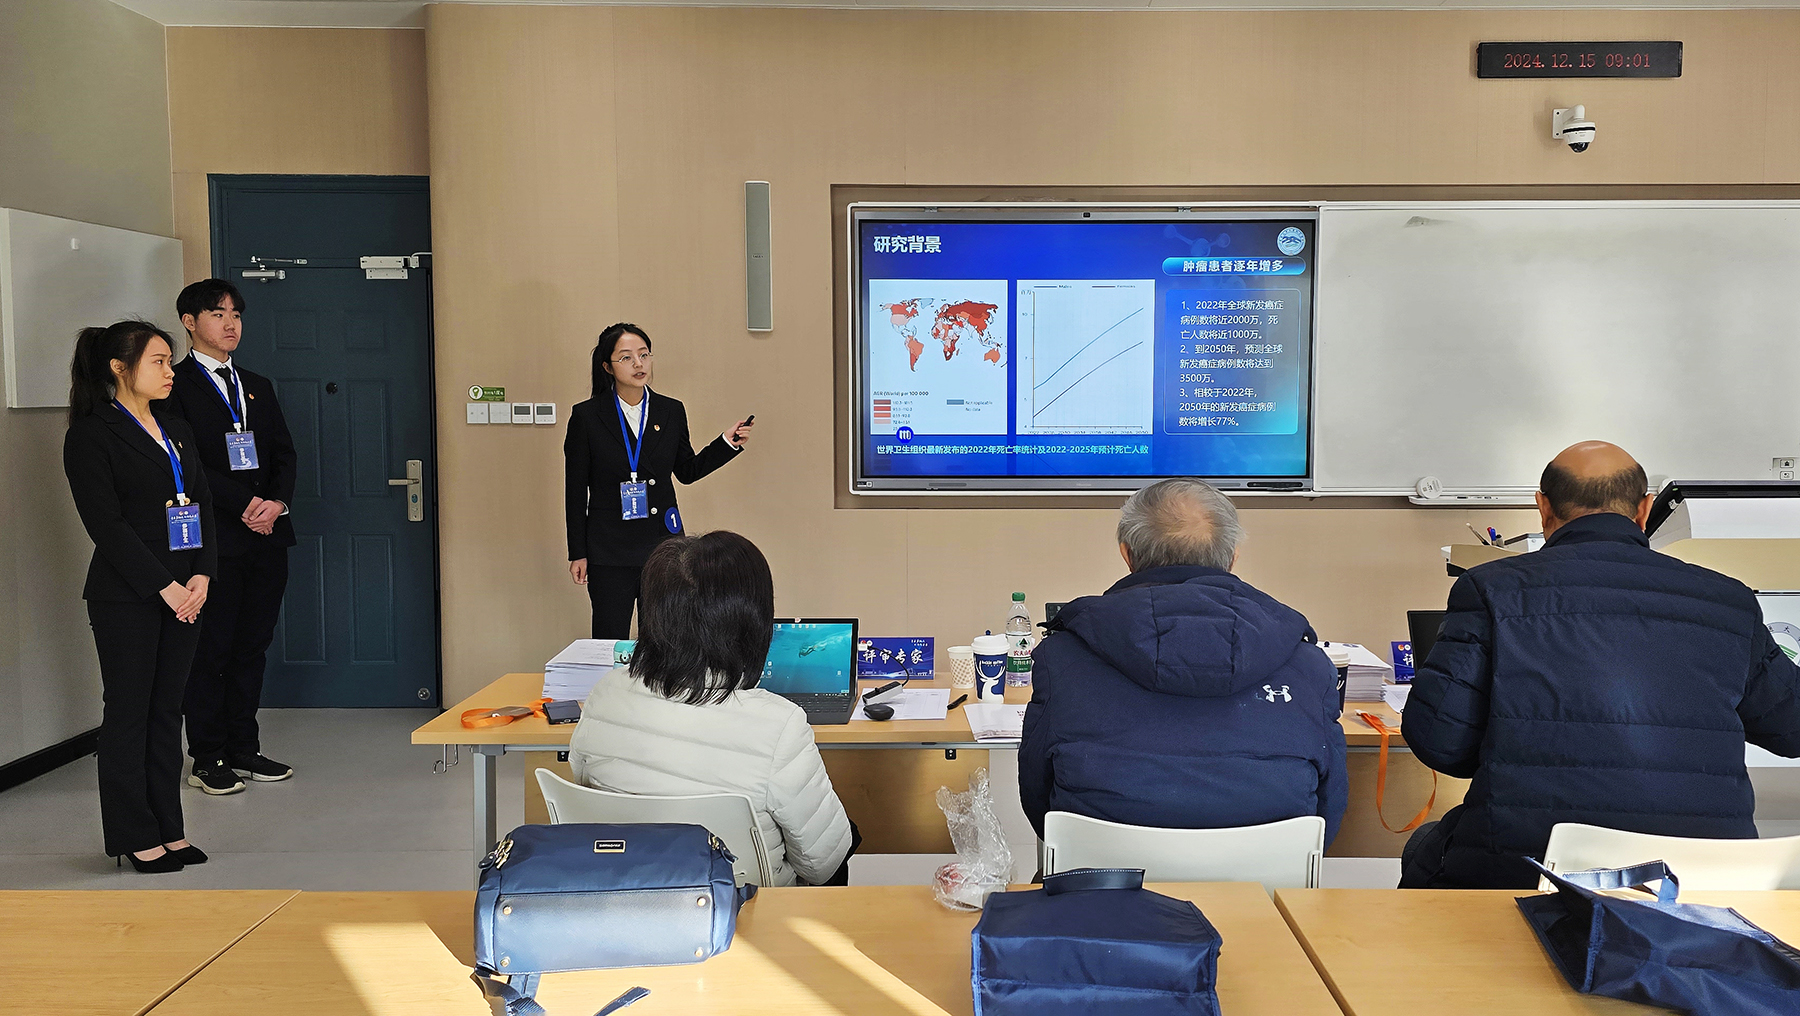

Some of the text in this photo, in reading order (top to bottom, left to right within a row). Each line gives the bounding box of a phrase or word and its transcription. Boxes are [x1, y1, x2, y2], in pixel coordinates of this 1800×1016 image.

[1605, 53, 1650, 68] 09:01
[873, 235, 942, 253] 研究背景
[1182, 259, 1284, 273] 肿瘤患者逐年增多
[1181, 300, 1284, 311] 1、2022年全球新发癌症
[1180, 329, 1263, 340] 亡人数将近1000万。
[1179, 358, 1274, 369] 新发癌症病例数将达到
[1179, 373, 1215, 384] 3500万。
[1178, 402, 1276, 413] 2050年的新发癌症病例
[1178, 416, 1240, 427] 数将增长77%。
[876, 445, 1149, 455] 世界卫生组织最新发布的2022年死亡率统计及2022-2025年预计死亡人数
[670, 513, 677, 528] 1
[862, 648, 924, 665] 评审专家
